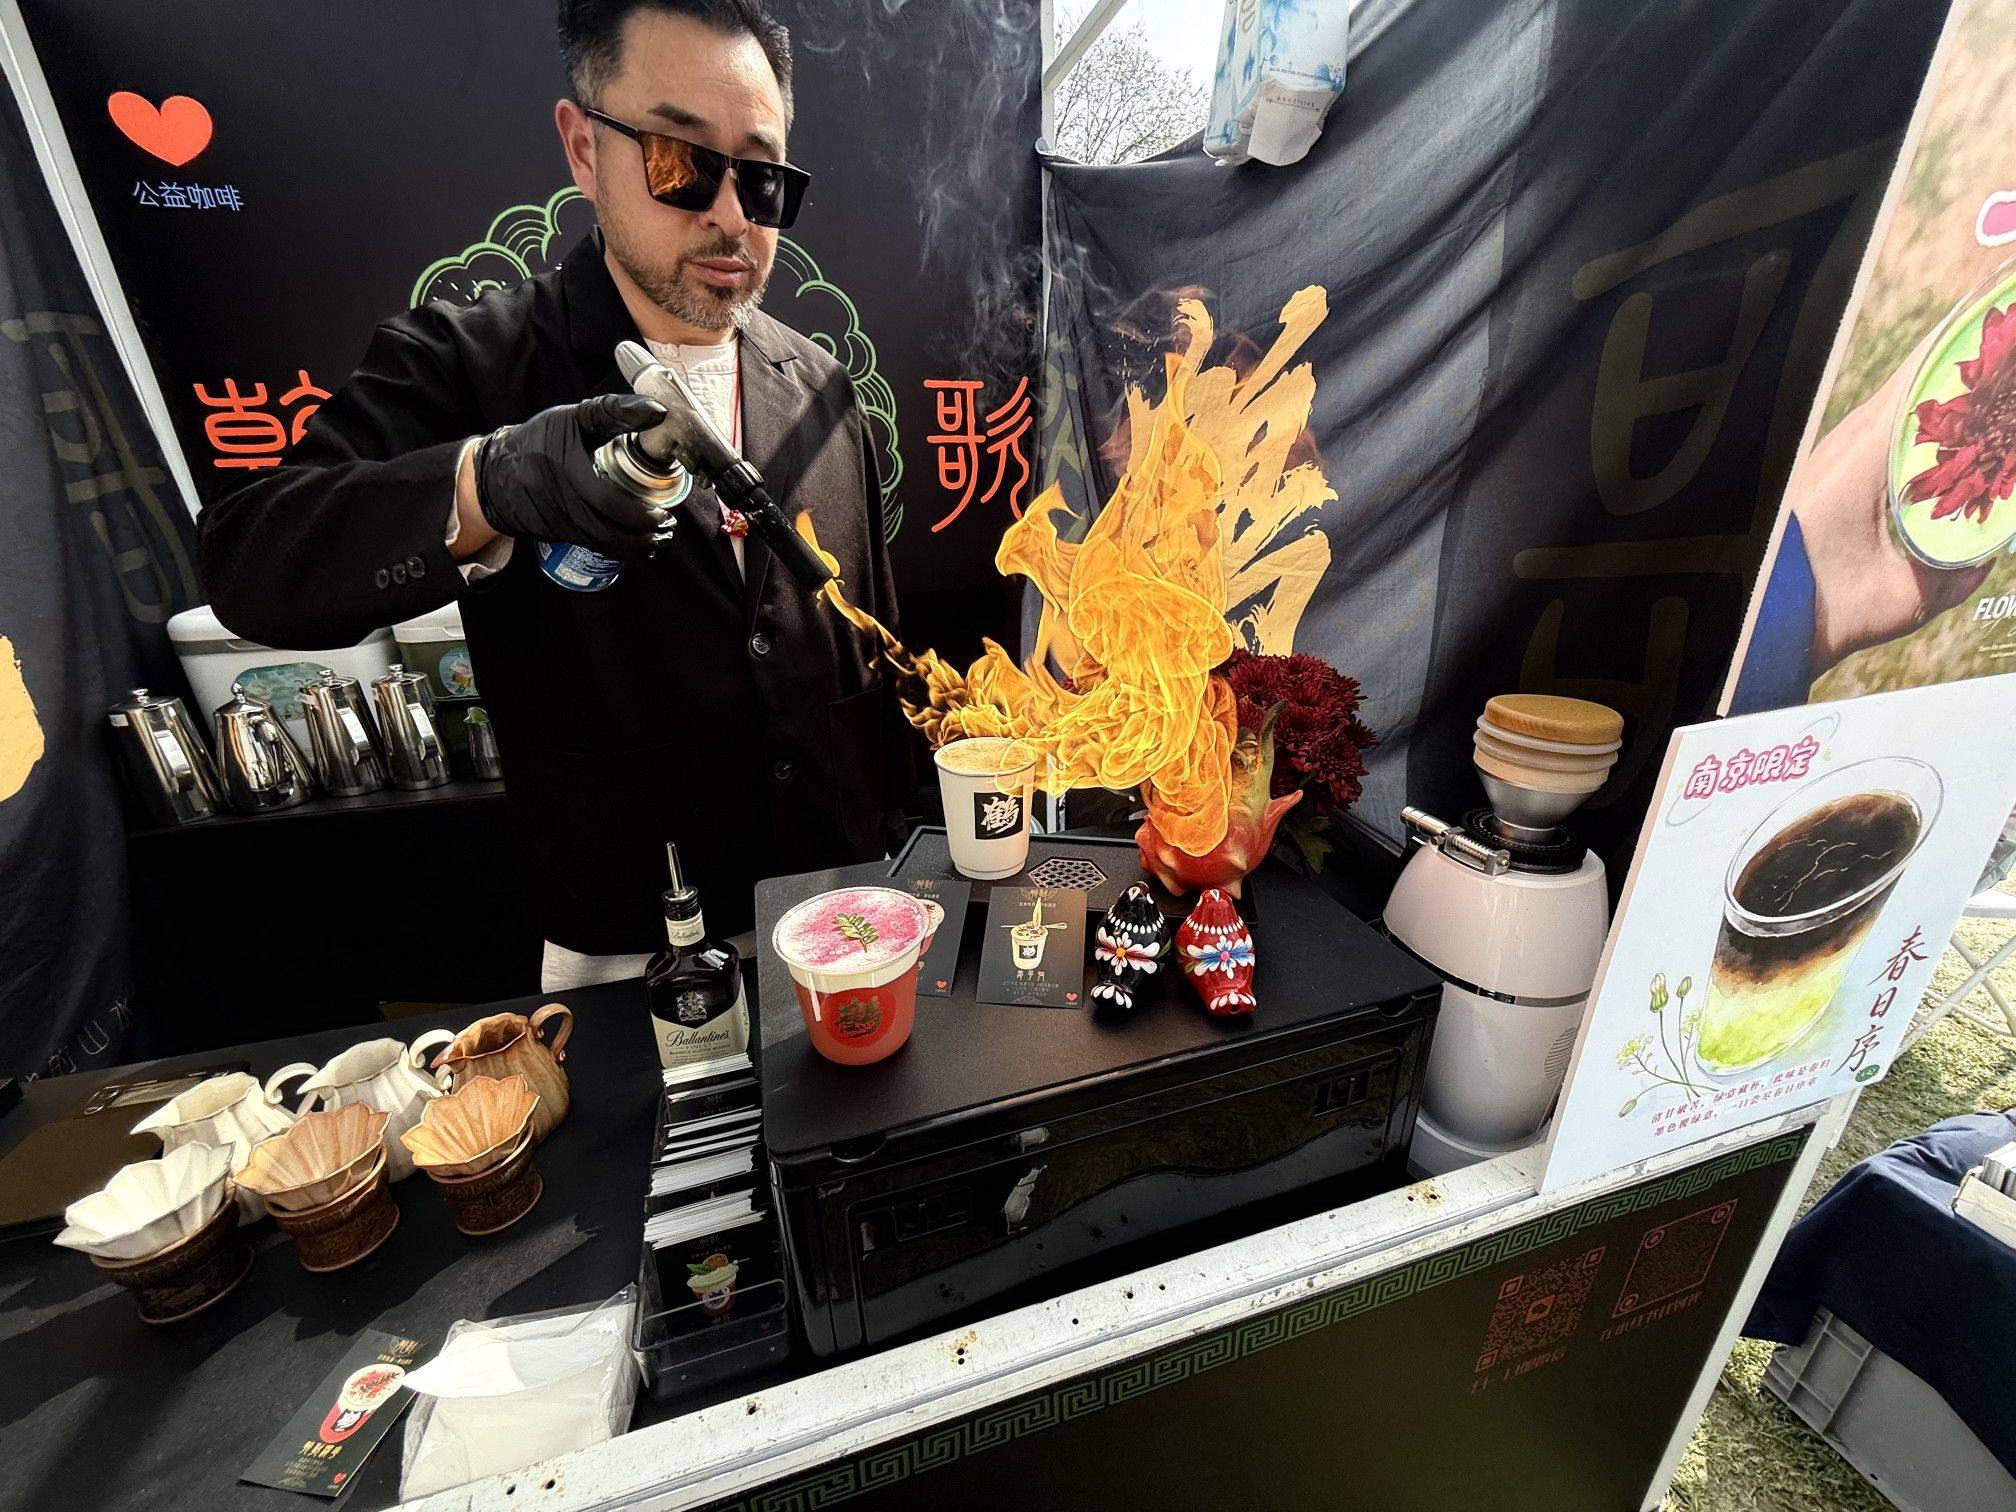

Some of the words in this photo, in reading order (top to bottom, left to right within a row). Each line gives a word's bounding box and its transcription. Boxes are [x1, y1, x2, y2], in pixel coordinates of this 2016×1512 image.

[132, 180, 244, 211] 公益咖啡
[1684, 736, 1820, 799] 南京限定
[1832, 925, 1929, 1077] 春日序
[666, 1030, 730, 1048] Ballantine's
